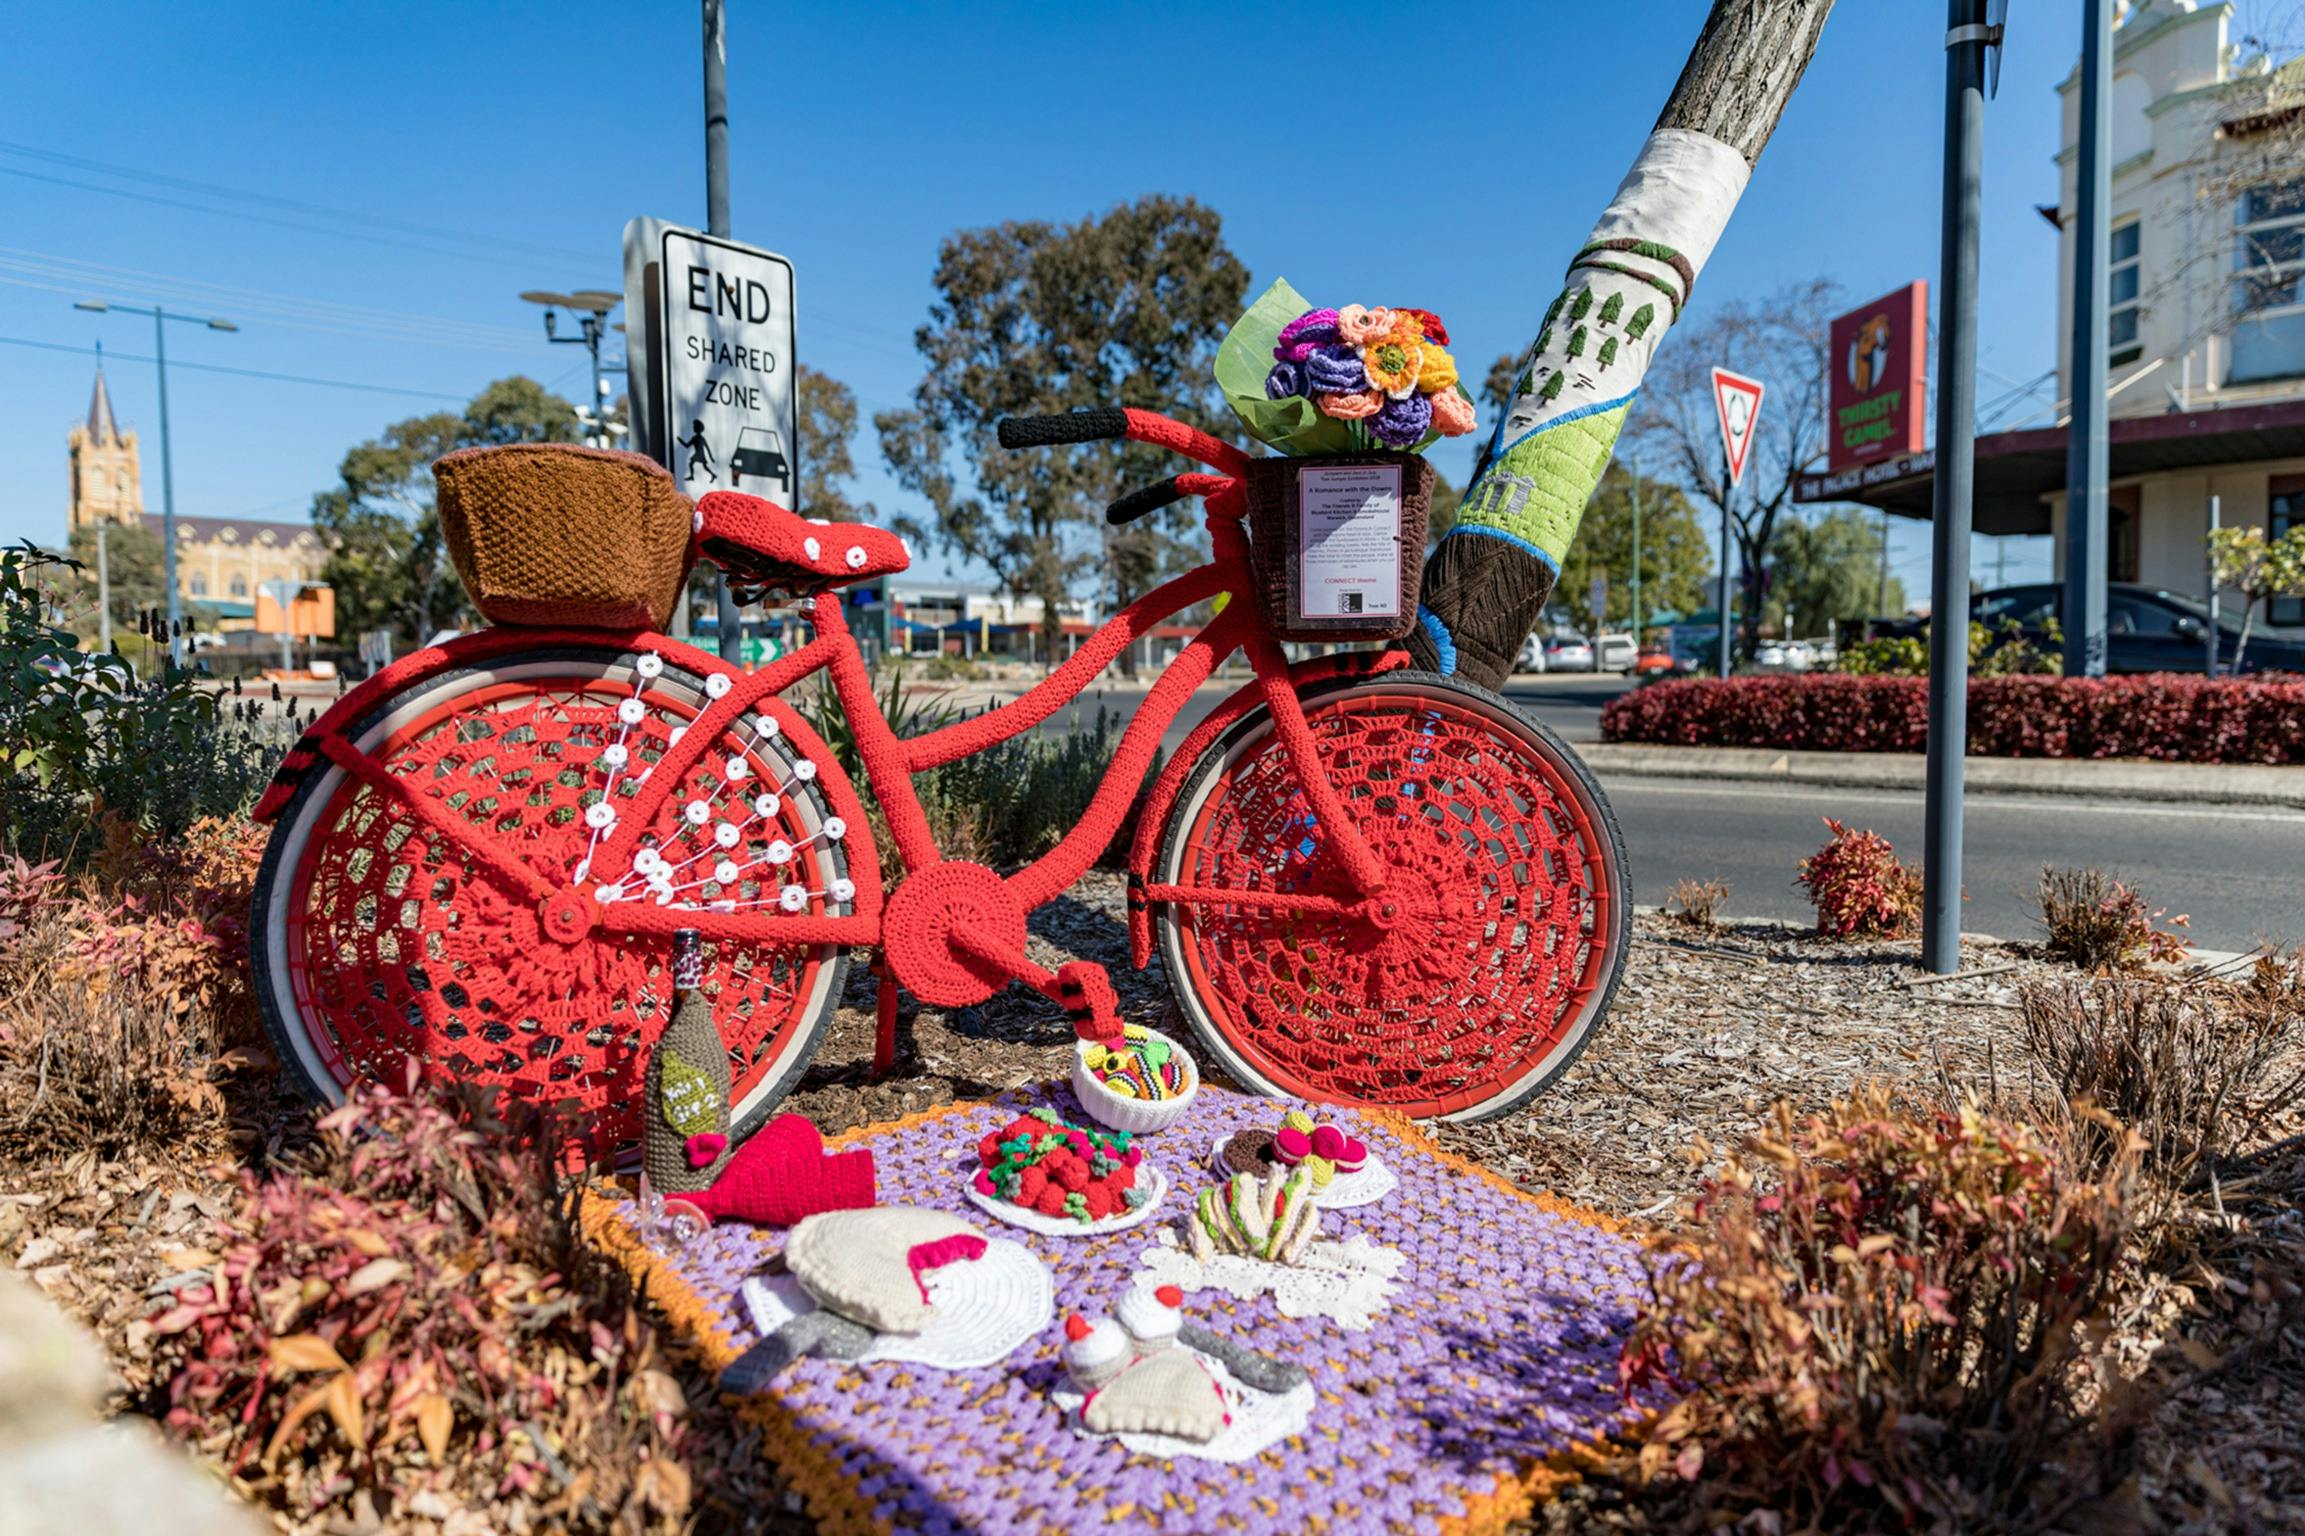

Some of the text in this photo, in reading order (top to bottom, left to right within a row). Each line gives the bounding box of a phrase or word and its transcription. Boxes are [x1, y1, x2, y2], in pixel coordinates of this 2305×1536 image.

[687, 264, 770, 324] END
[687, 335, 775, 374] SHARED
[705, 379, 760, 411] ZONE
[1838, 391, 1902, 429] THIRSTY
[1843, 420, 1897, 448] CAMEL
[1801, 479, 1820, 500] THE
[695, 1077, 706, 1091] 1
[704, 1093, 720, 1110] 2
